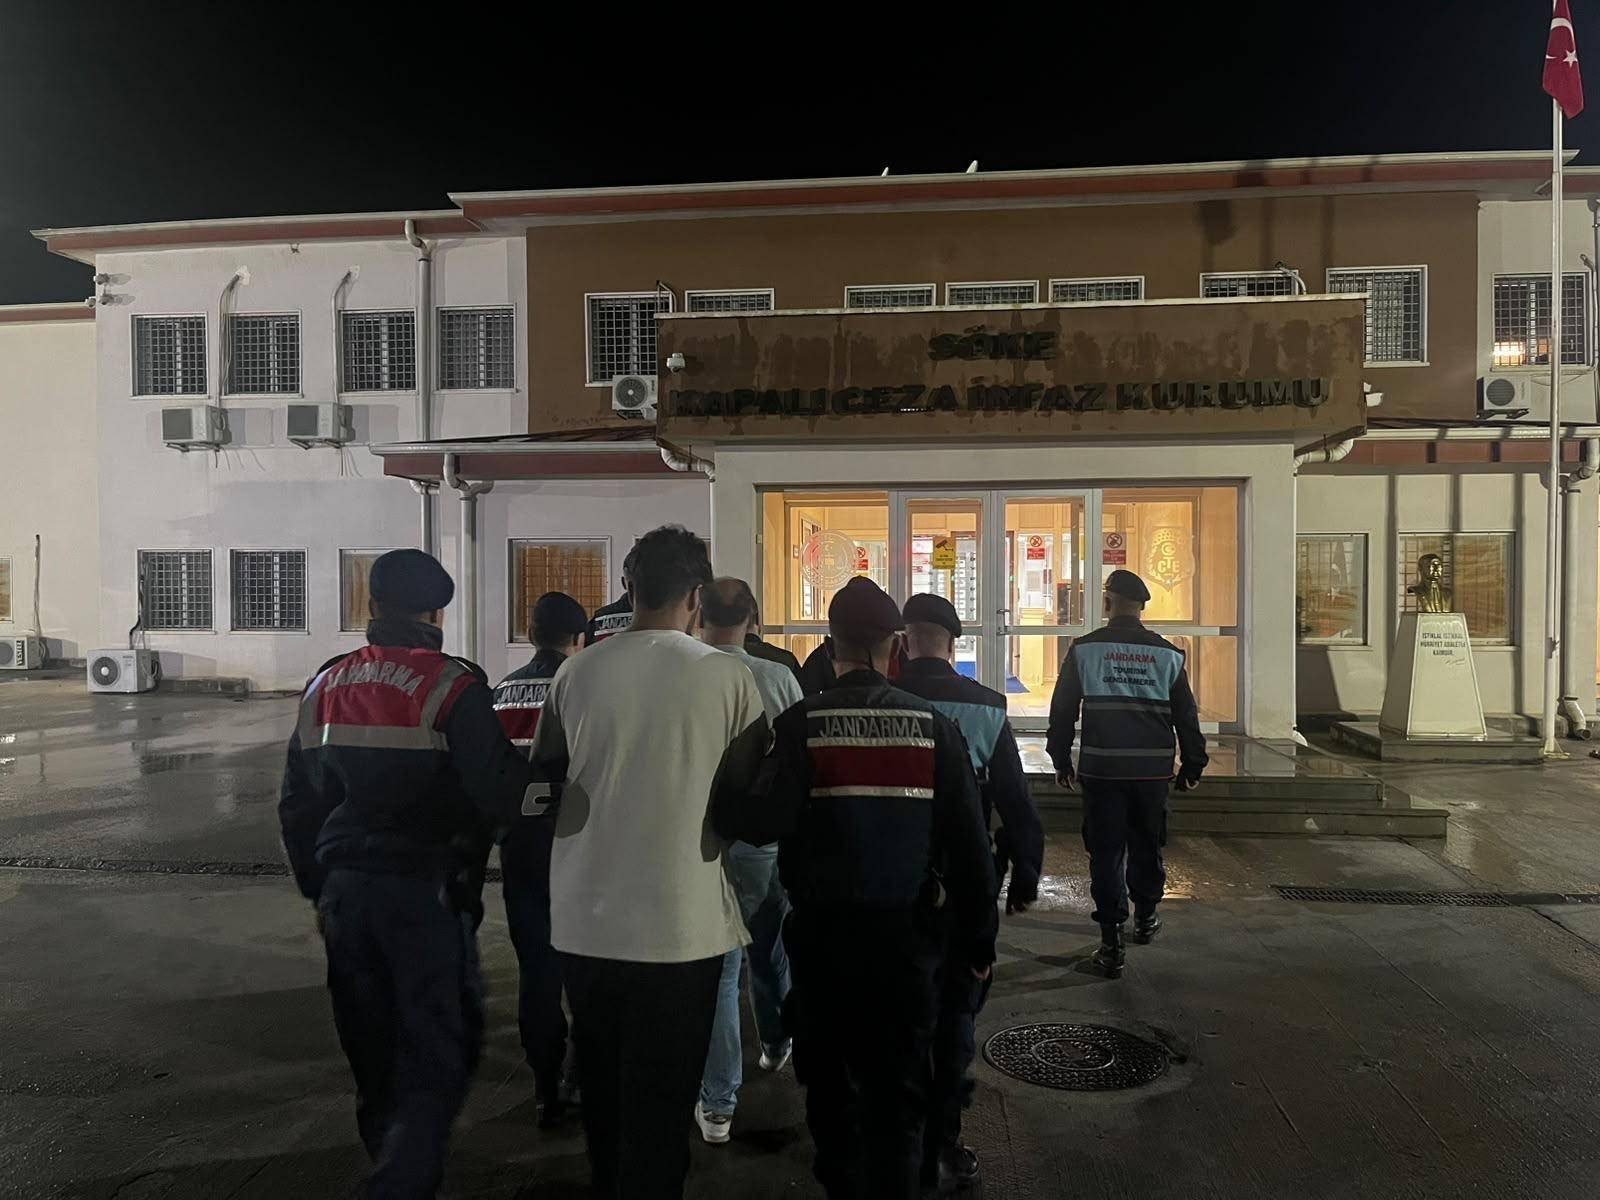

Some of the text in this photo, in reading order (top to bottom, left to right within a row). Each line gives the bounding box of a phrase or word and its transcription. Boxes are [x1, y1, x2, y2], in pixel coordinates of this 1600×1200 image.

[1115, 377, 1329, 412] KURUMU
[1104, 651, 1156, 664] JANDARMA
[324, 660, 426, 697] JANDARMA
[818, 714, 923, 738] JANDARMA
